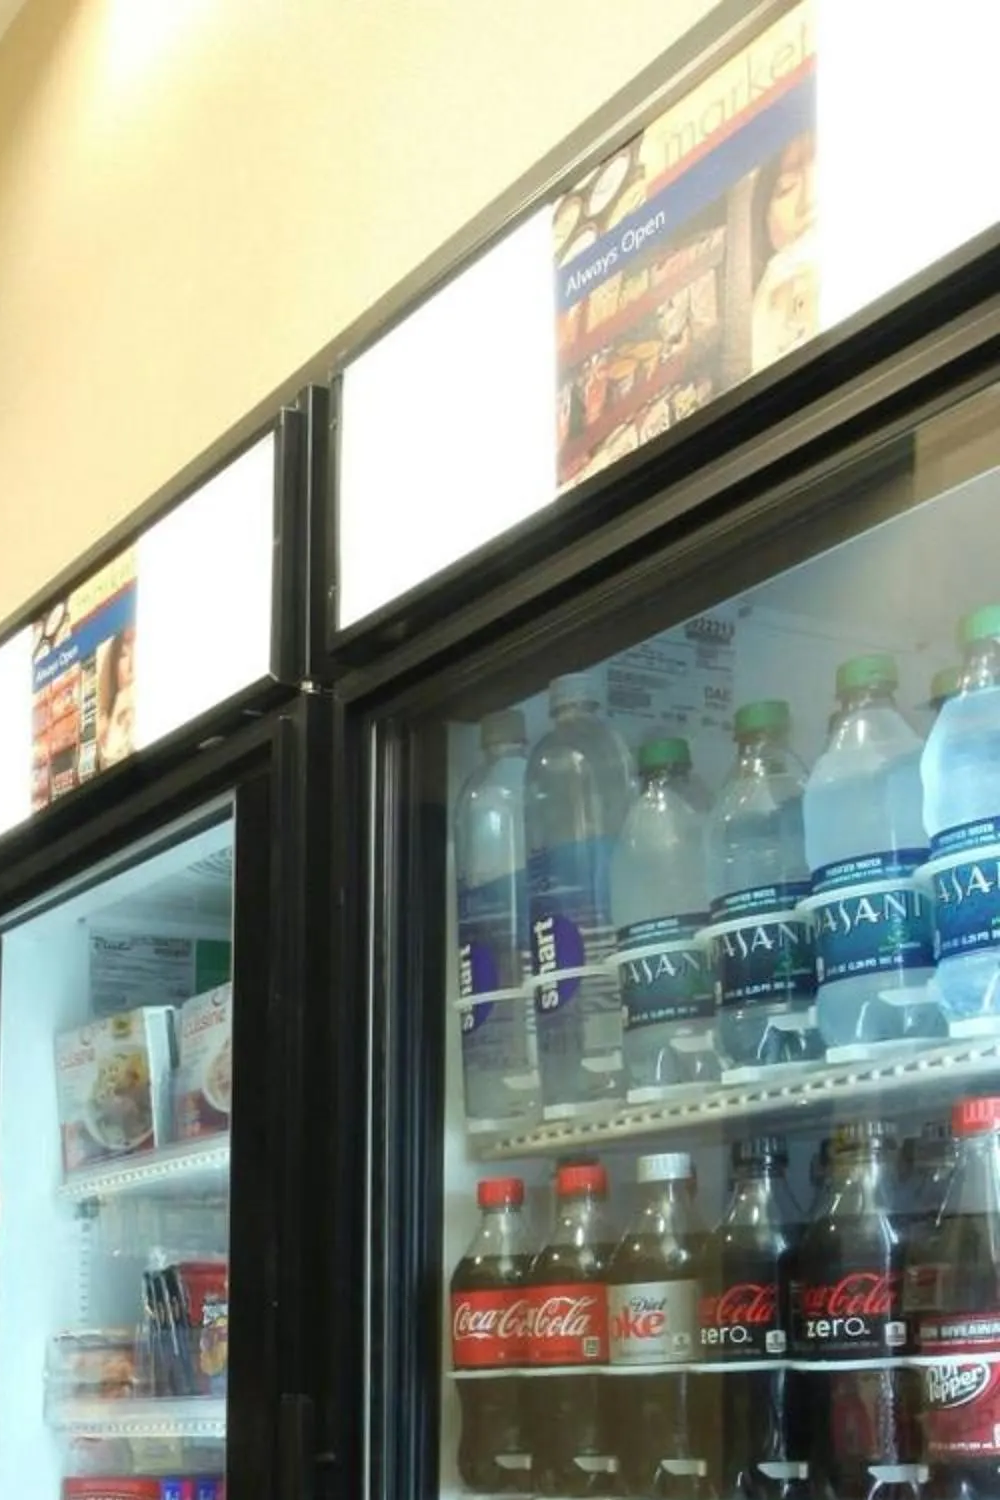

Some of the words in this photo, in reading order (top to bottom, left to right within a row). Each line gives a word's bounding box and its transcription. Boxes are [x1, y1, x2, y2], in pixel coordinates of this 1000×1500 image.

[565, 244, 620, 297] Always
[621, 210, 667, 253] Open
[630, 1298, 667, 1313] Diet
[701, 1325, 748, 1345] zero
[806, 1316, 866, 1338] zero
